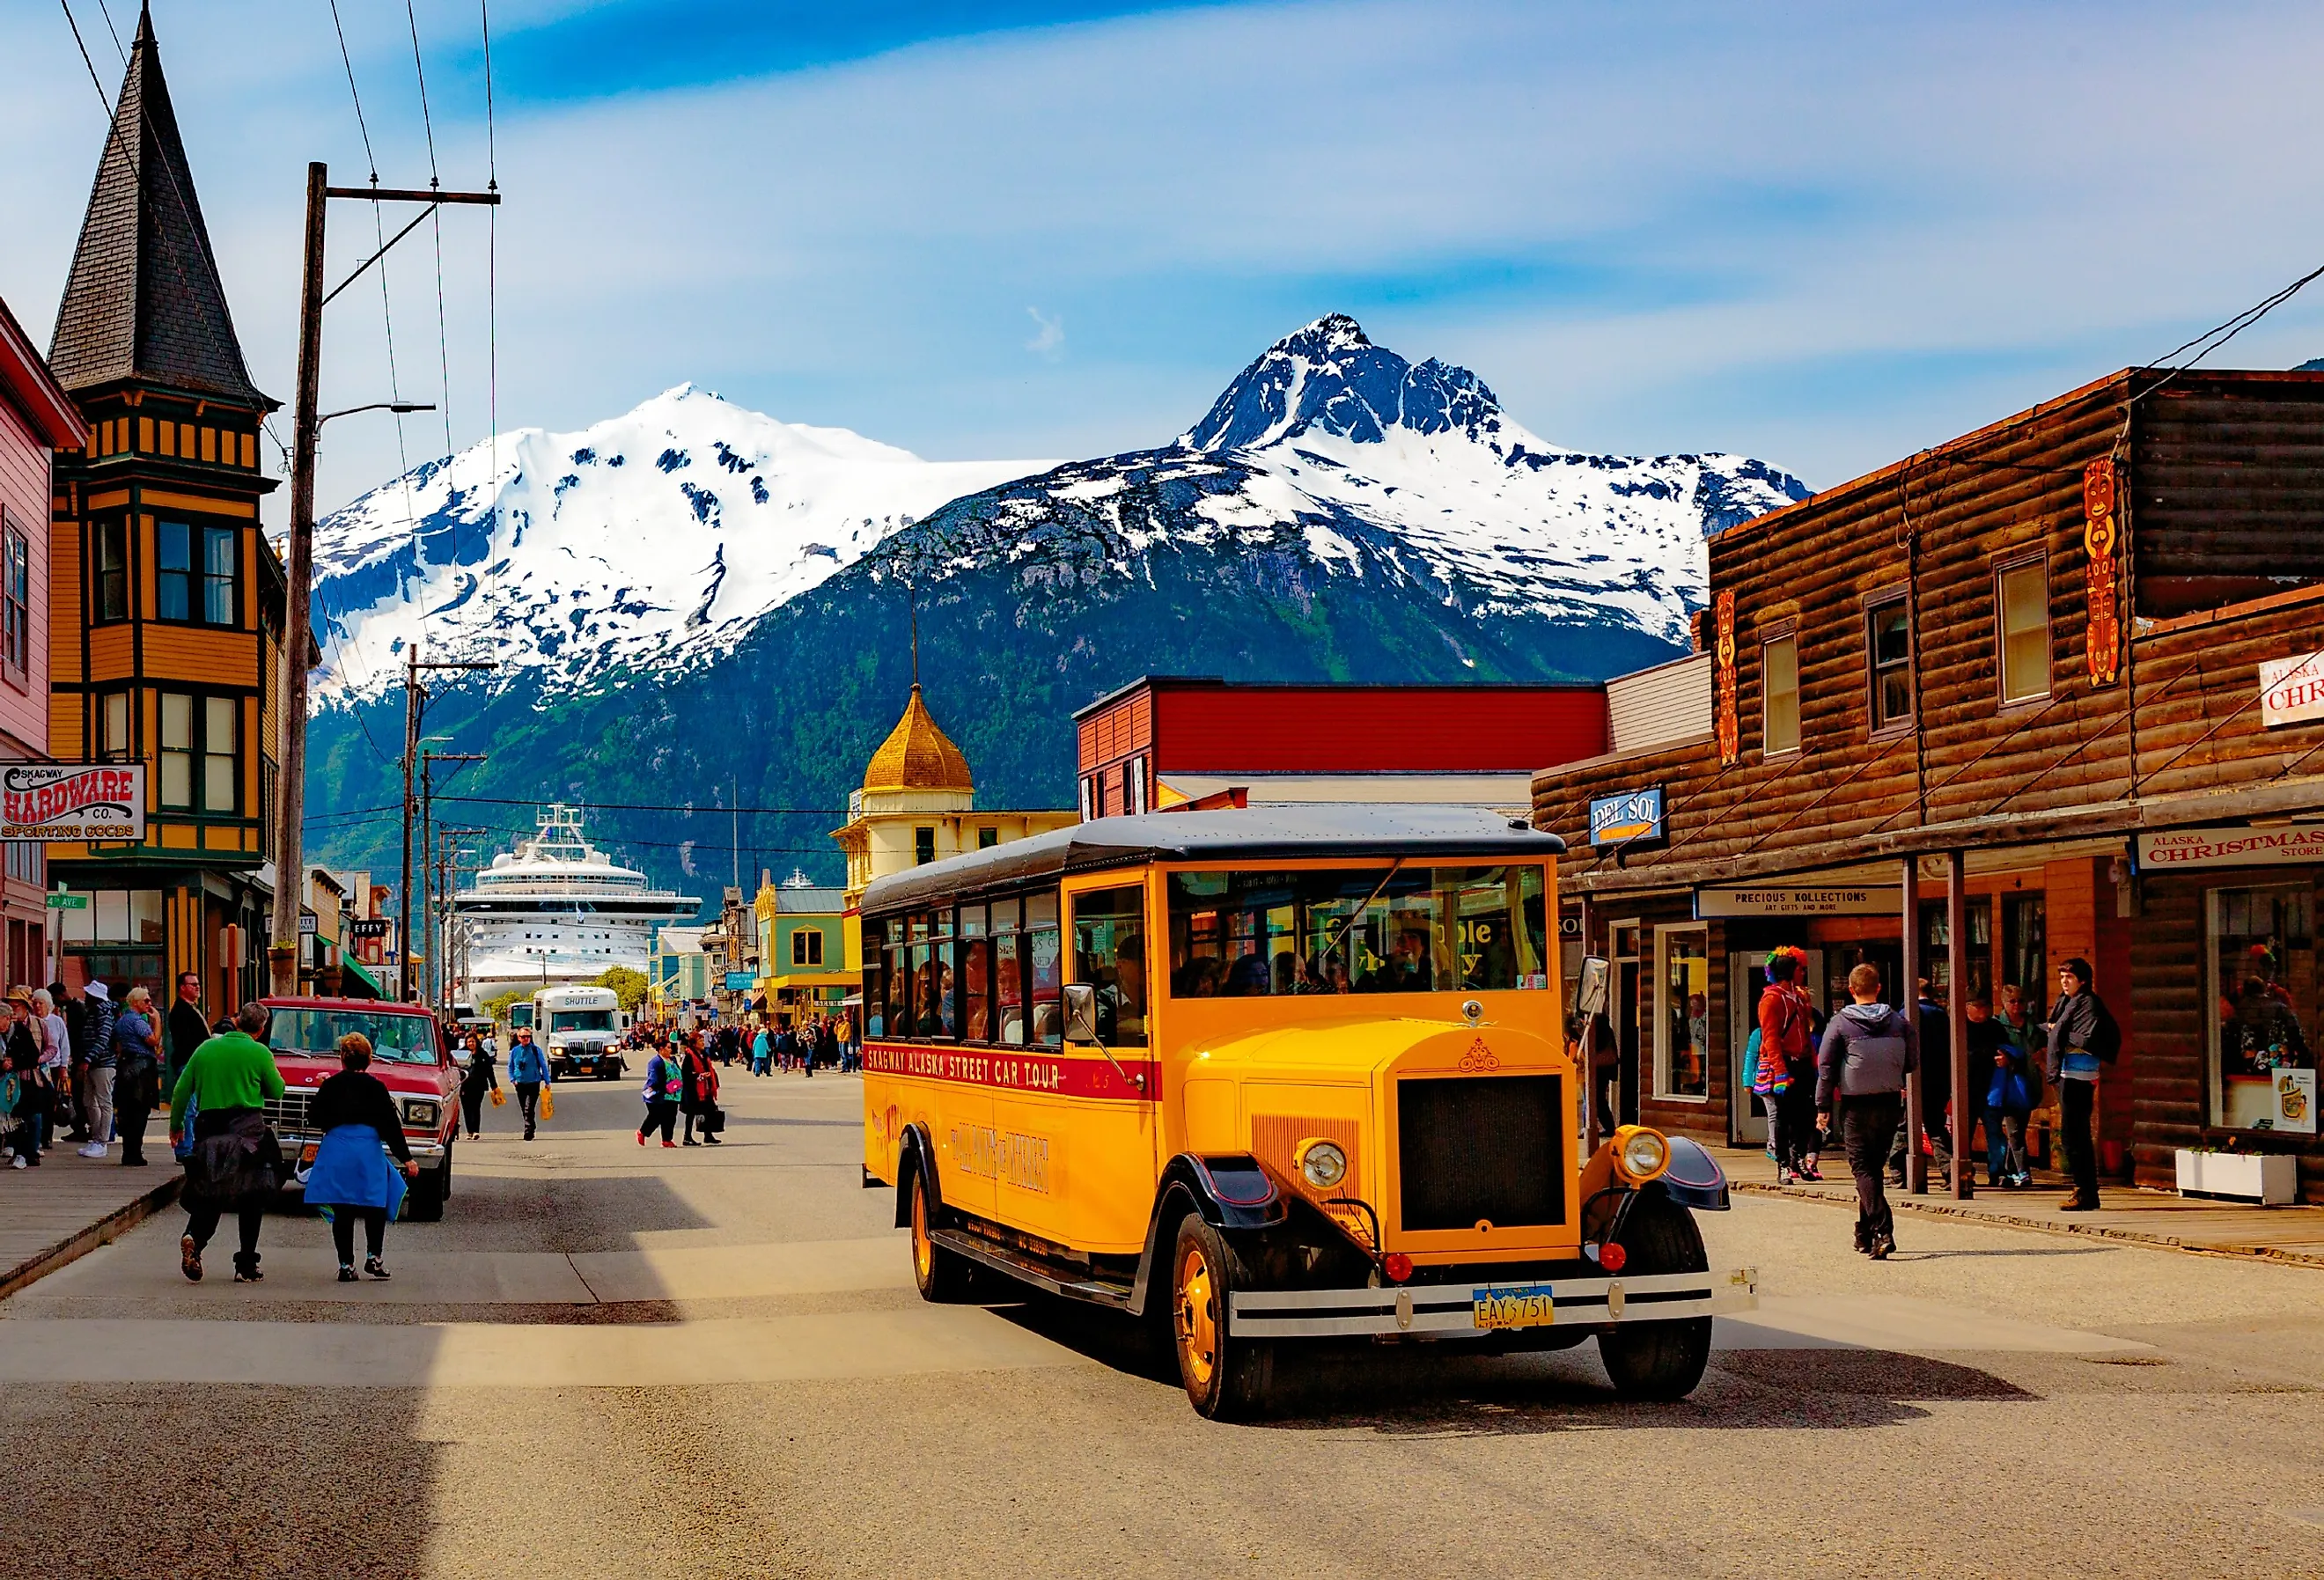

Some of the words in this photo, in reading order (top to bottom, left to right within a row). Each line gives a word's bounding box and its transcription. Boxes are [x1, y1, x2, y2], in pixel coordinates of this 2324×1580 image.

[2272, 664, 2319, 683] ALASKA
[21, 769, 63, 778] SKAGWAY
[4, 770, 134, 823] HARDWARE
[92, 808, 112, 819] CO.
[1593, 799, 1624, 834] DEL
[1629, 797, 1658, 823] SOL
[2, 825, 81, 837] SPORTING
[85, 825, 134, 837] GOODS
[2148, 830, 2324, 862] CHRISTMAS
[2153, 836, 2204, 846] ALASKA
[2282, 847, 2323, 856] STORE
[63, 898, 77, 907] AVE
[1735, 893, 1785, 903] PRECIOUS
[1795, 893, 1867, 902] KOLLECTIONS
[355, 924, 382, 933] EFFY
[868, 1050, 905, 1071] SKAGWAY
[908, 1053, 945, 1076] ALASKA
[949, 1056, 989, 1081] STREET
[995, 1061, 1019, 1085] CAR
[1025, 1062, 1059, 1090] TOUR
